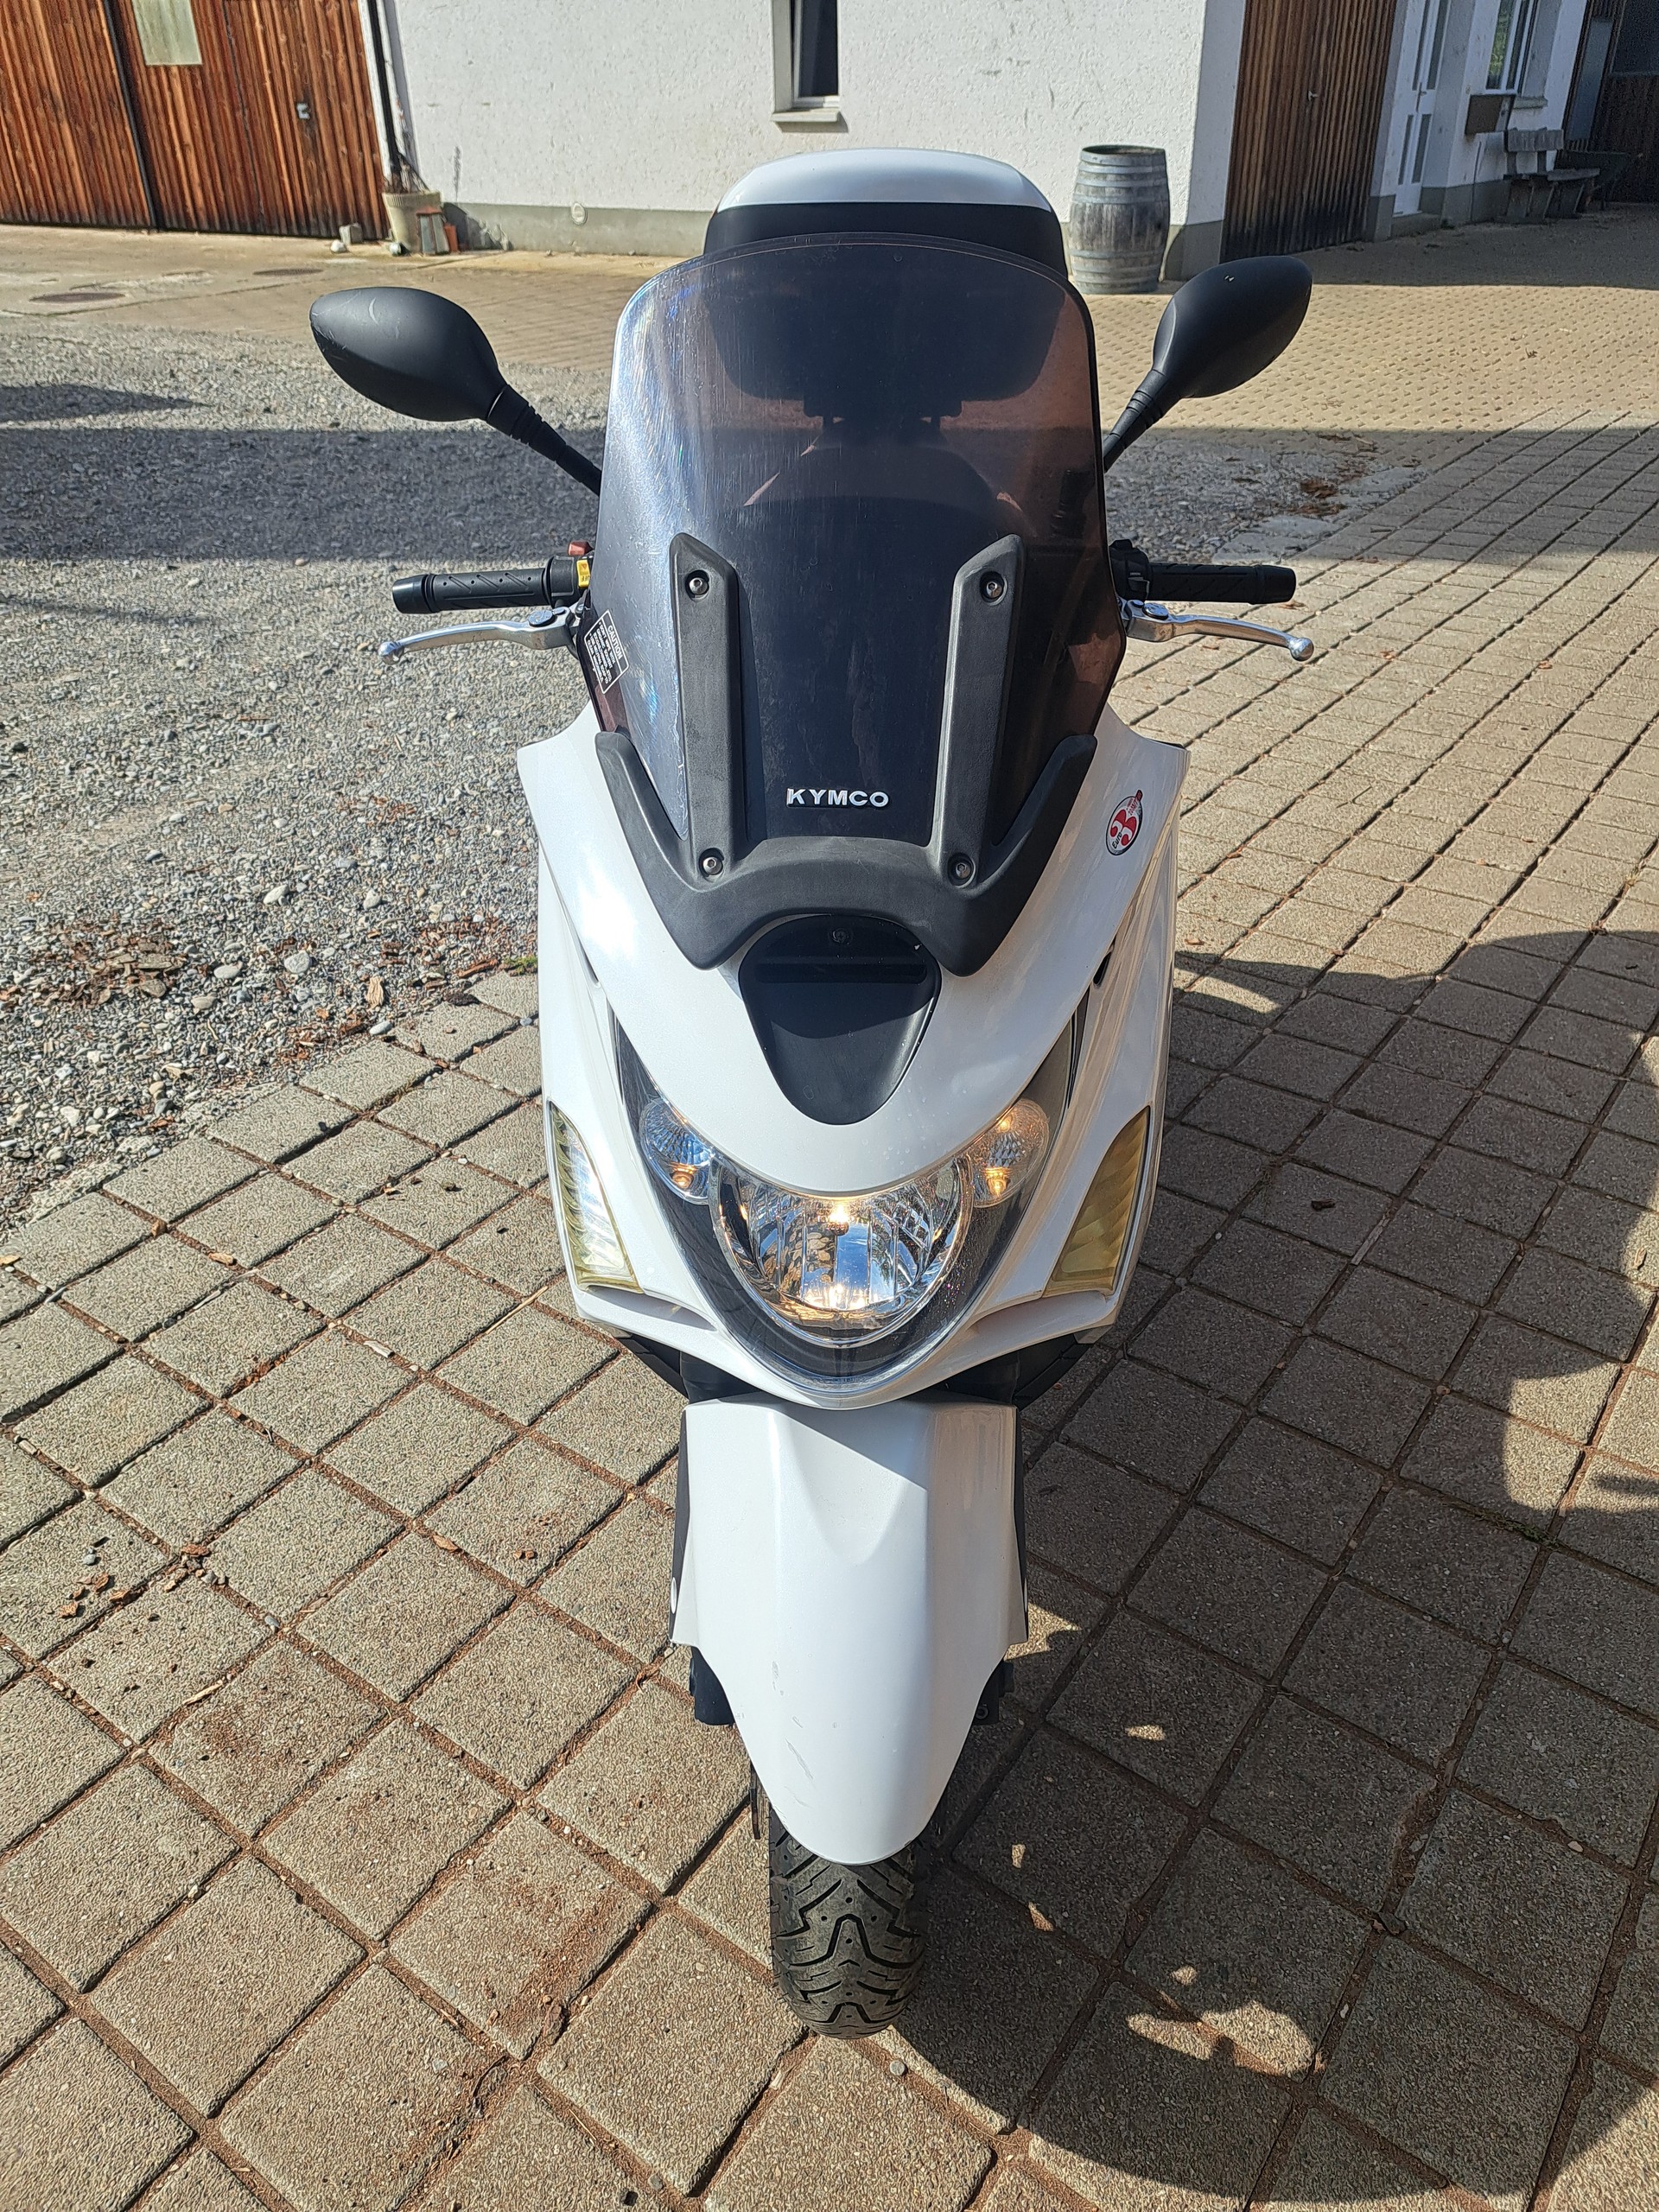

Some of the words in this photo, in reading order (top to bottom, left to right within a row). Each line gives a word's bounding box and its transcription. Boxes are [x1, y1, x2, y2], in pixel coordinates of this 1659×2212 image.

[607, 625, 623, 660] CAUTION
[786, 788, 889, 807] KYMCO
[1111, 831, 1122, 849] Euro
